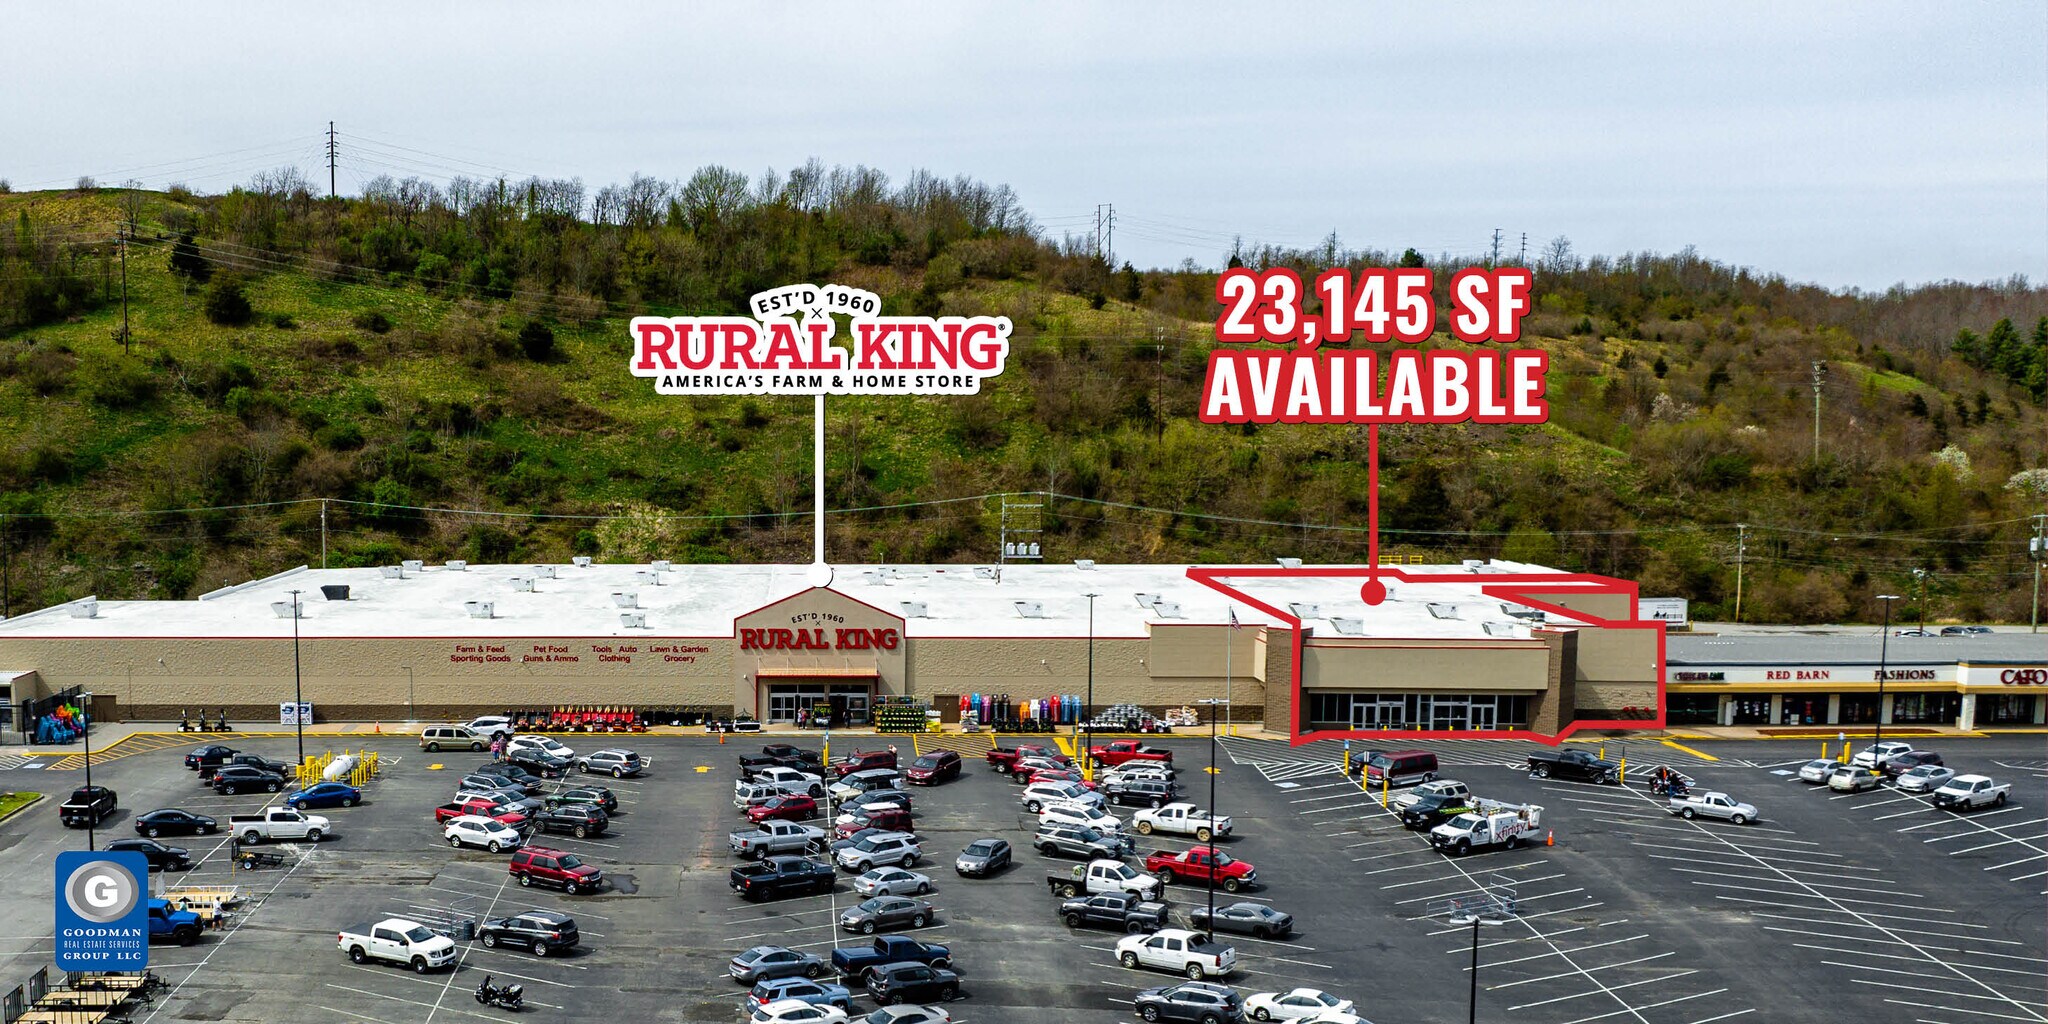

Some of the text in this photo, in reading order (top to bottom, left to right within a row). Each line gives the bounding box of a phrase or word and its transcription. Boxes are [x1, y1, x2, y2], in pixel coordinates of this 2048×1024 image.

[822, 612, 844, 624] 1960
[740, 628, 898, 650] RURAL KING
[456, 645, 505, 653] Farm & Feed
[533, 645, 568, 653] Pet Food
[592, 645, 638, 653] Tools Auto
[650, 645, 709, 653] Lawn & Garden
[450, 655, 511, 663] Sporting Goods
[598, 655, 631, 663] Clothing
[664, 655, 696, 664] Grocery
[1766, 670, 1830, 680] RED BARN
